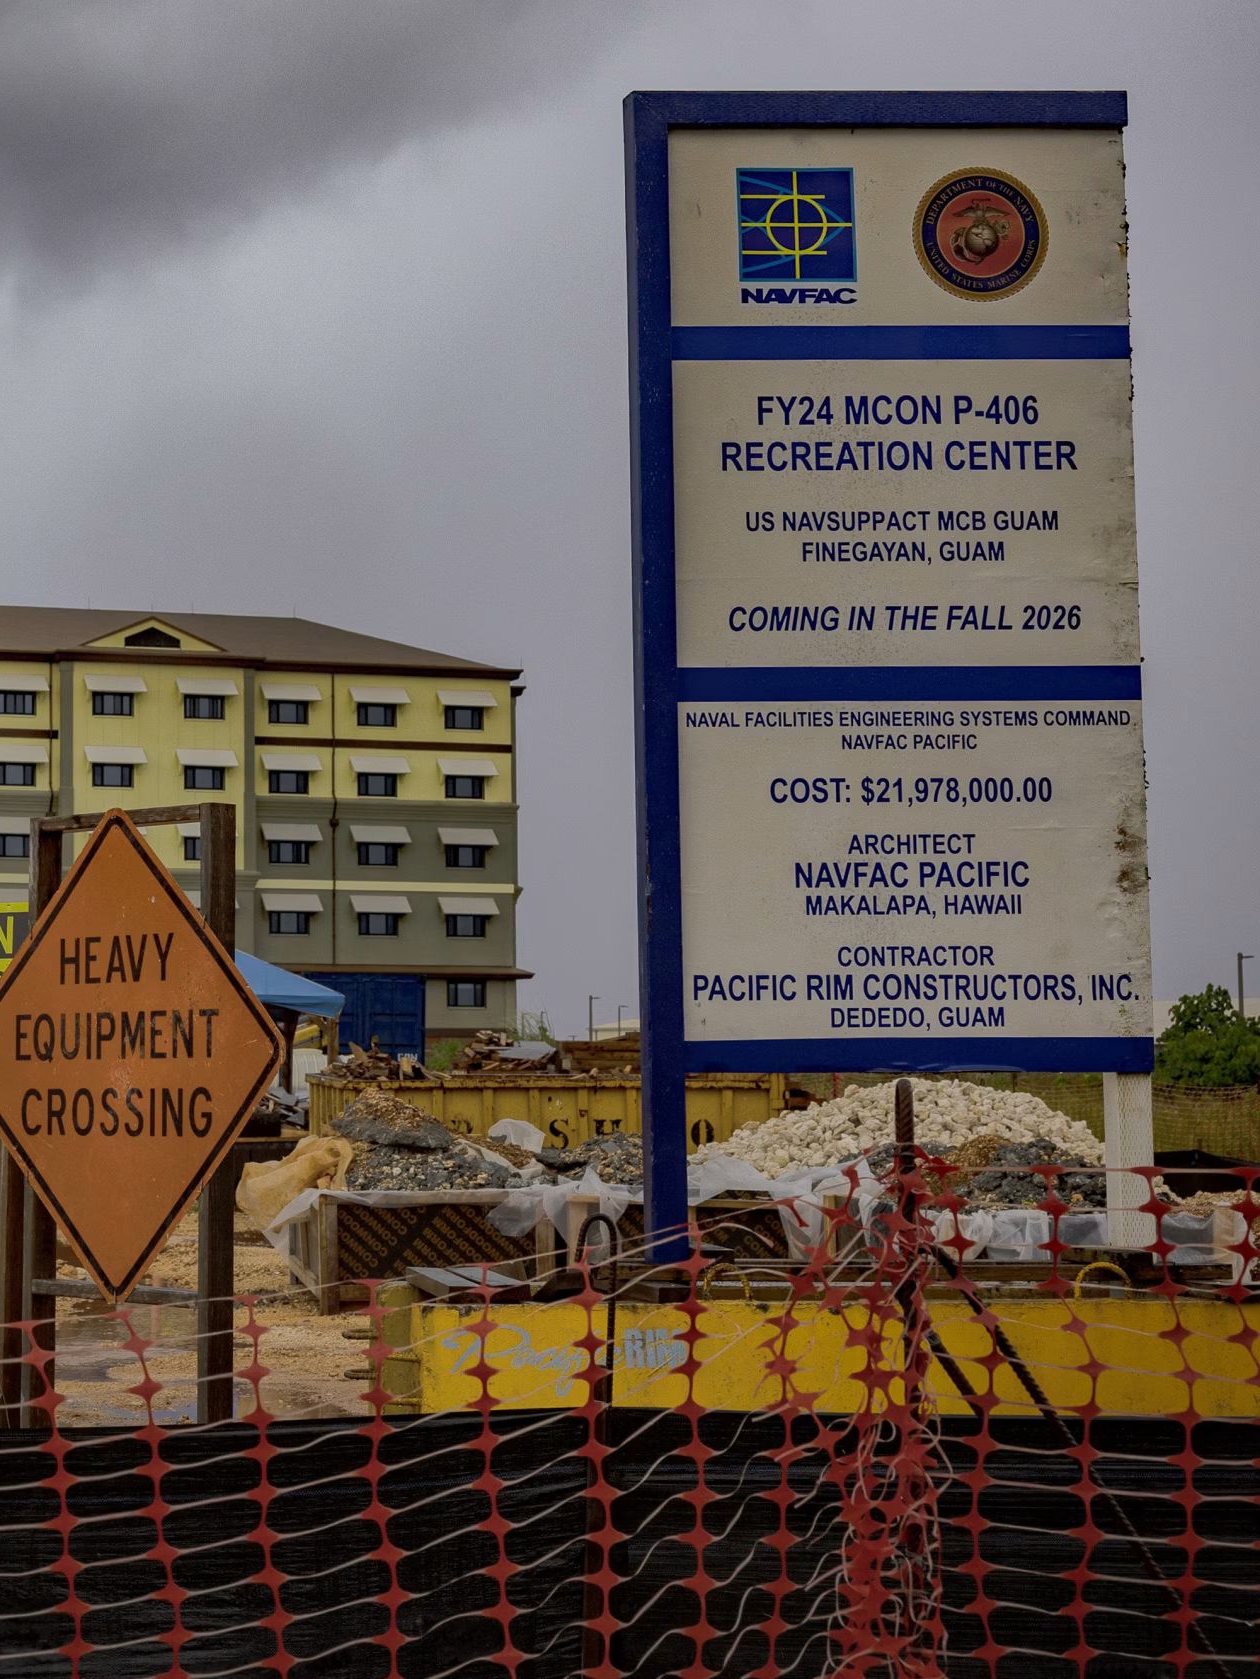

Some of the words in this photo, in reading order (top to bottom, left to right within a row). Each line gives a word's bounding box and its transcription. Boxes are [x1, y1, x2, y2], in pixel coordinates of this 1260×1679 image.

[926, 178, 983, 225] DEPARTMENT
[1014, 196, 1035, 222] NAVY
[987, 271, 1021, 289] MARINE
[741, 288, 857, 304] NAVFAC
[758, 396, 833, 425] FY24
[845, 395, 941, 425] MCON
[954, 395, 1038, 424] P-406
[722, 441, 932, 471] RECREATION
[945, 441, 1077, 470] CENTER
[746, 512, 774, 531] US
[783, 511, 930, 531] NAVSUPPACT
[938, 511, 986, 531] MCB
[994, 511, 1058, 530] GUAM
[802, 542, 931, 565] FINEGAYAN,
[940, 541, 1004, 561] GUAM
[729, 606, 839, 631] COMING
[848, 606, 875, 630] IN
[885, 606, 938, 630] THE
[947, 605, 1012, 630] FALL
[1022, 605, 1081, 630] 2026
[686, 712, 740, 727] NAVAL
[746, 712, 833, 727] FACILITIES
[840, 711, 954, 726] ENGINEERING
[960, 711, 1038, 726] SYSTEMS
[1043, 711, 1131, 727] COMMAND
[842, 735, 907, 749] NAVFAC
[914, 734, 977, 749] PACIFIC
[770, 778, 850, 803] COST:
[861, 776, 1052, 807] $21,978,000.00
[848, 834, 975, 854] ARCHITECT
[795, 862, 908, 888] NAVFAC
[920, 861, 1029, 887] PACIFIC
[806, 895, 936, 919] MAKALAPA,
[945, 894, 1021, 914] HAWAII
[59, 932, 174, 985] HEAVY
[838, 946, 994, 967] CONTRACTOR
[694, 975, 796, 1001] PACIFIC
[807, 975, 853, 1000] RIM
[864, 974, 1082, 1006] CONSTRUCTORS,
[1092, 974, 1139, 1000] INC.
[831, 1007, 930, 1031] DEDEDO,
[939, 1007, 1004, 1027] GUAM
[15, 1009, 219, 1063] EQUIPMENT
[21, 1086, 213, 1138] CROSSING
